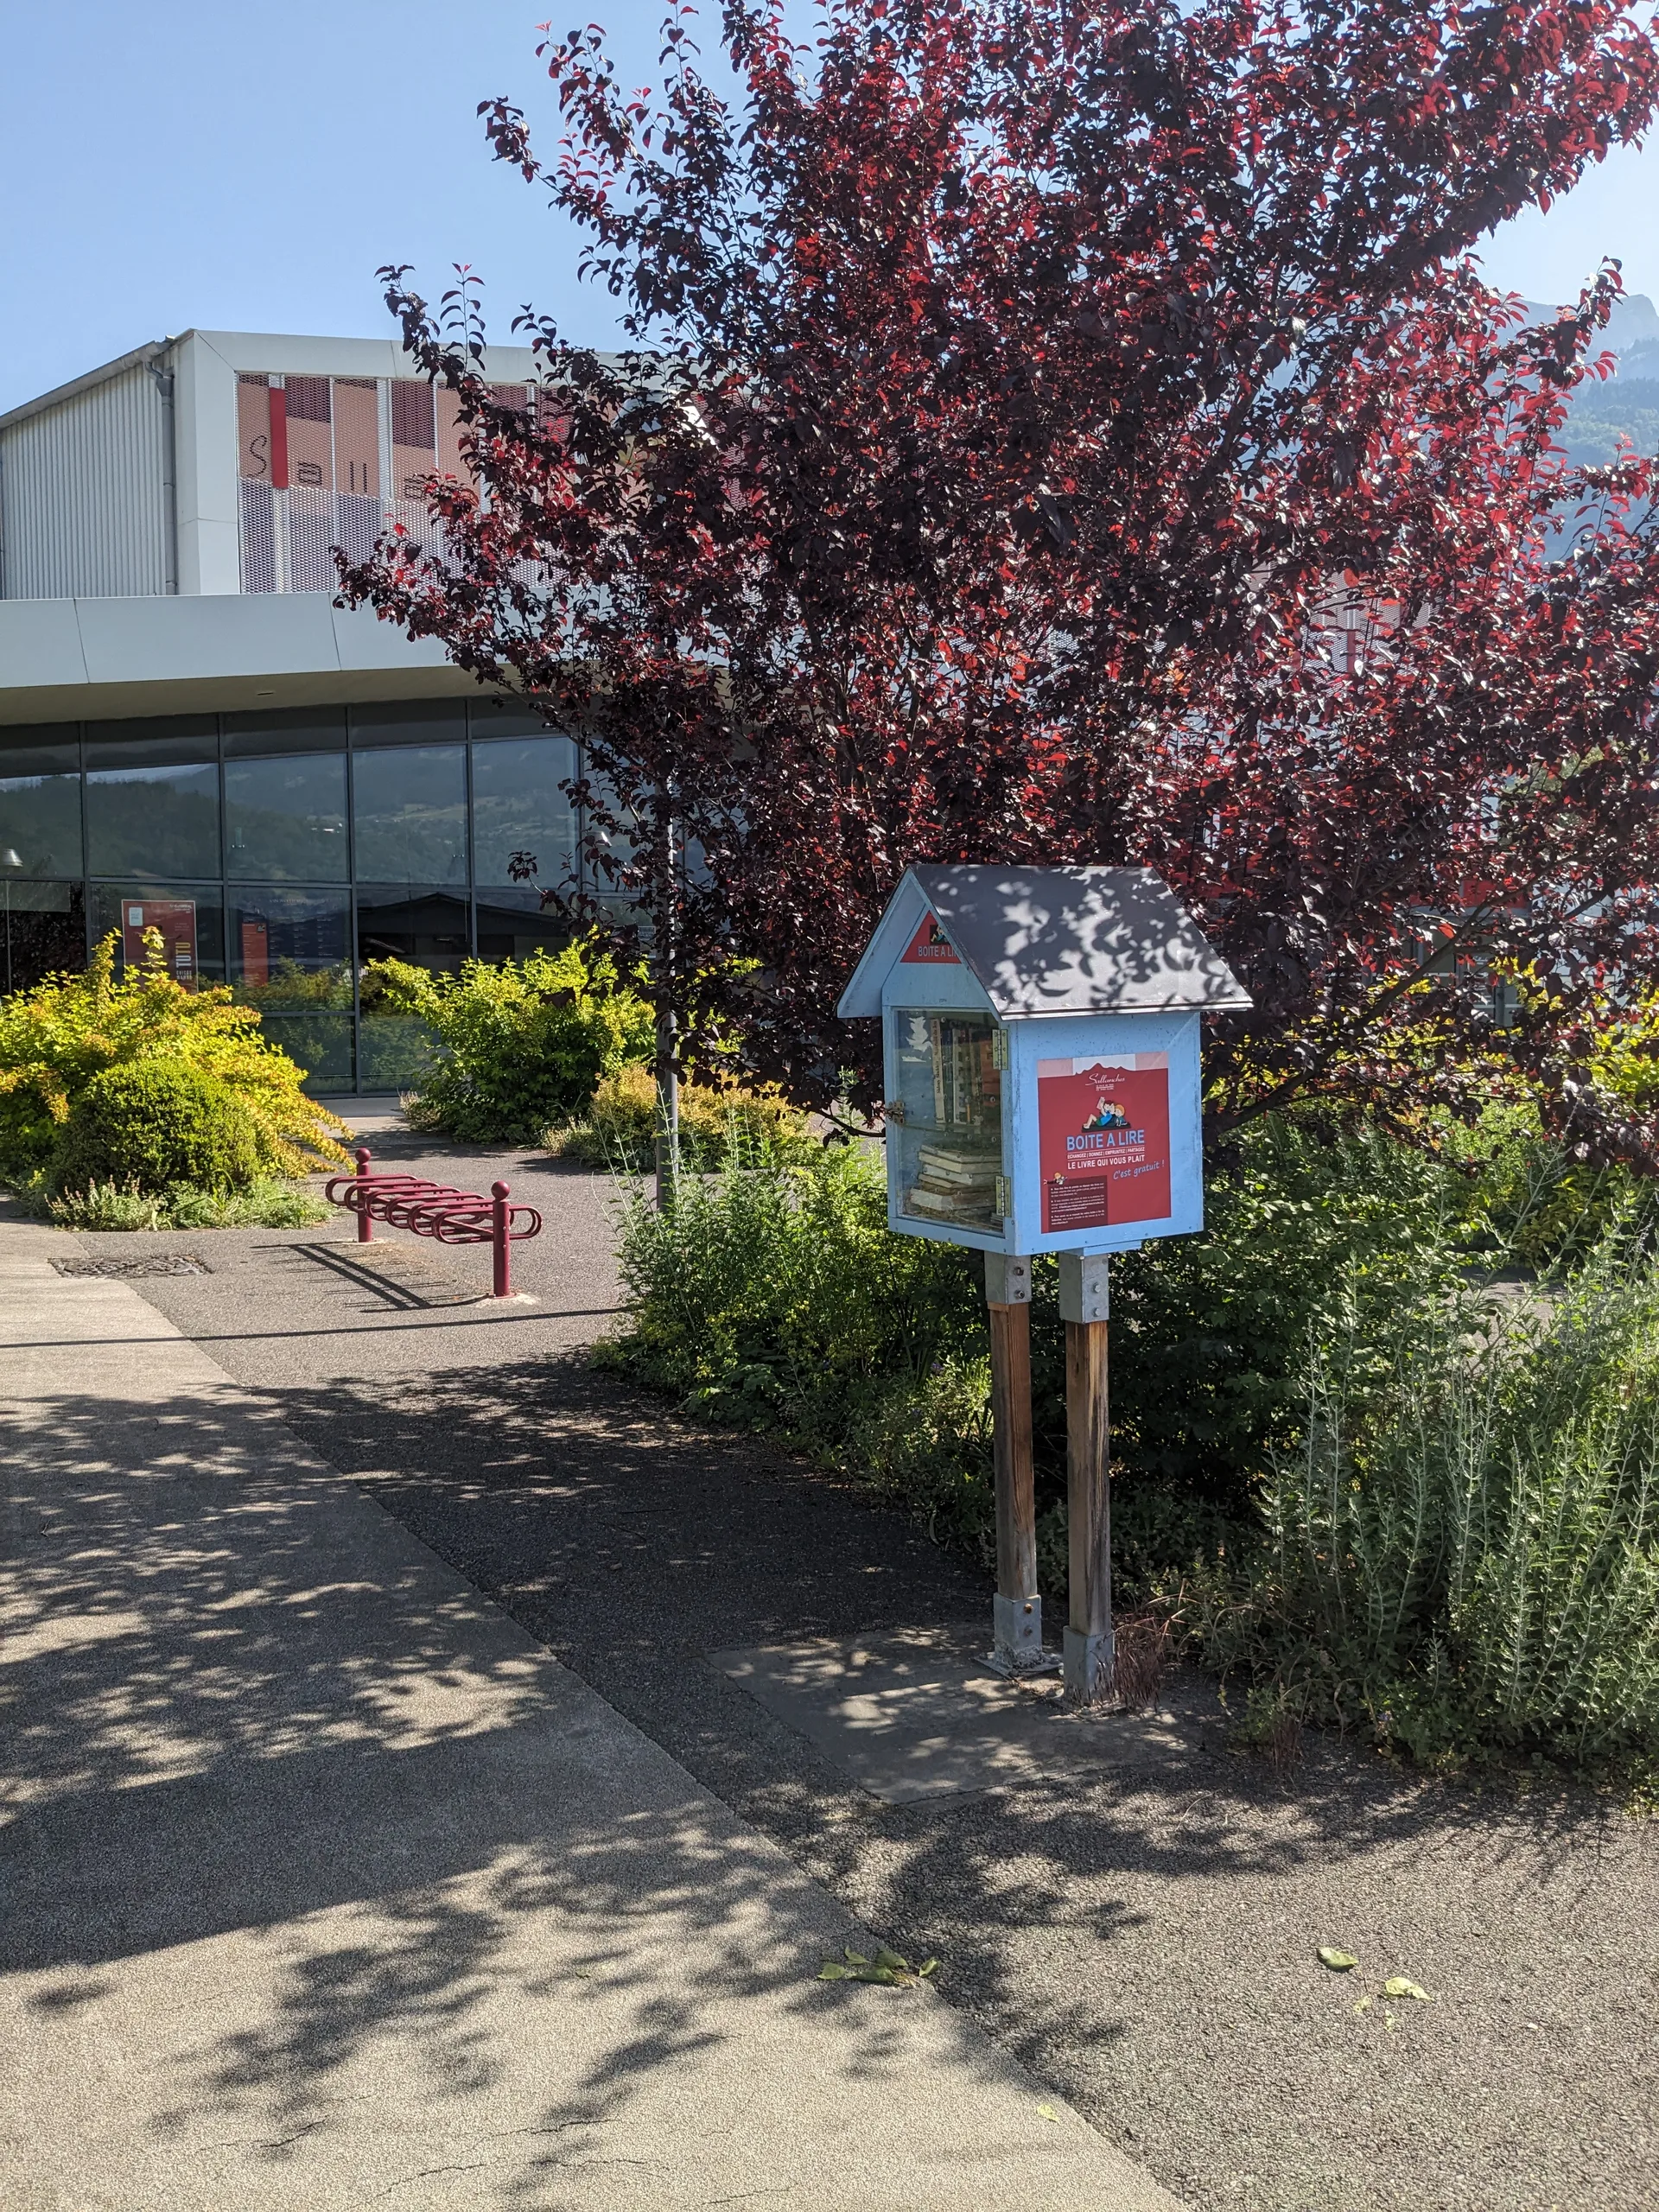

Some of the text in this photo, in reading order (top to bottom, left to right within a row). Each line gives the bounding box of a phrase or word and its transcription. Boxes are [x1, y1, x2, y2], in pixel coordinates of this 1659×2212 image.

[175, 942, 192, 968] TUTU
[918, 945, 939, 957] BOITE
[940, 945, 946, 957] A
[1085, 1073, 1125, 1086] Sallanches
[1066, 1129, 1145, 1151] BOITE A LIRE
[1067, 1161, 1077, 1170] LE
[1077, 1160, 1096, 1169] LIVRE
[1109, 1156, 1127, 1165] VOUS
[1128, 1154, 1146, 1163] PLAIT
[1113, 1169, 1132, 1180] C'est
[1134, 1161, 1160, 1177] gratuit
